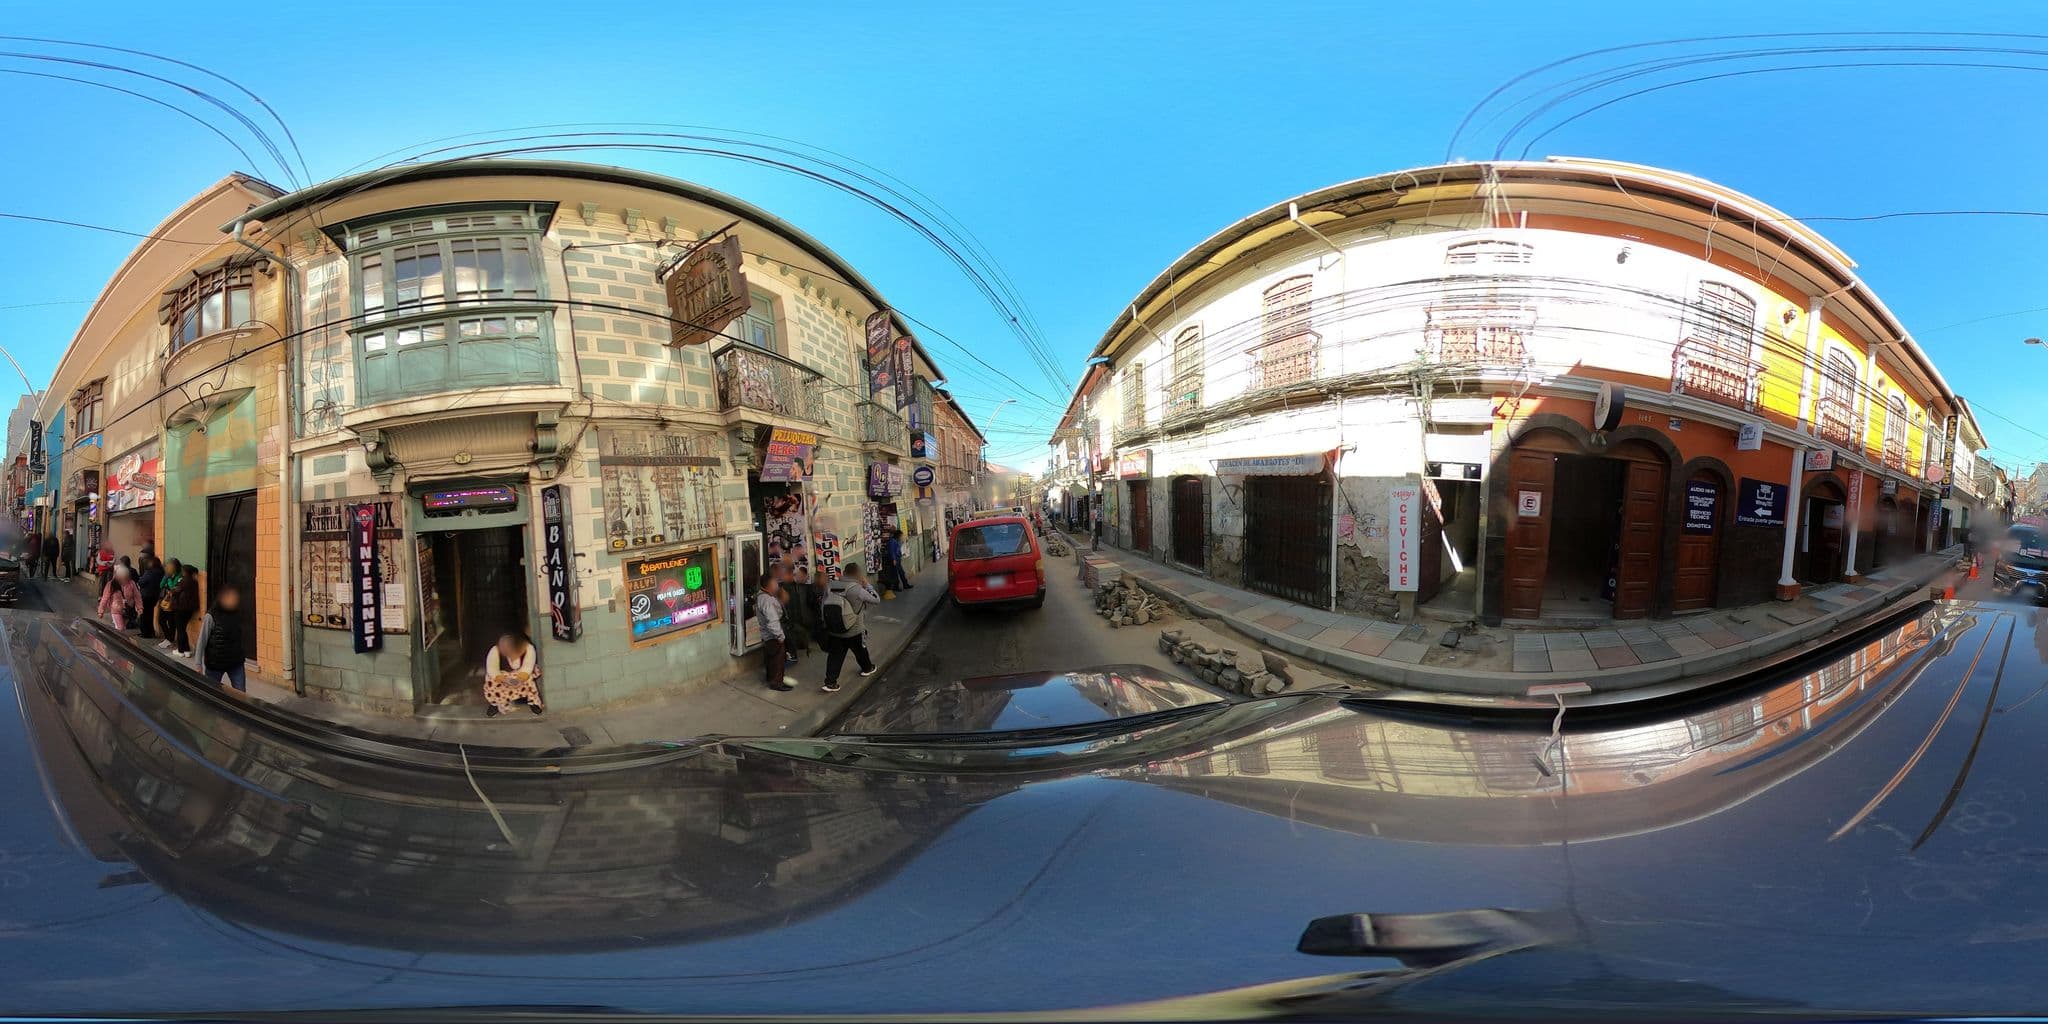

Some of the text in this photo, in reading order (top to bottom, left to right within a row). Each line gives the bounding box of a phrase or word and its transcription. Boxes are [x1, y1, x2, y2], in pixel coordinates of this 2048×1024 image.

[550, 525, 566, 609] BAÑO
[1399, 503, 1408, 586] CEVICHE
[359, 531, 376, 648] INTERNET
